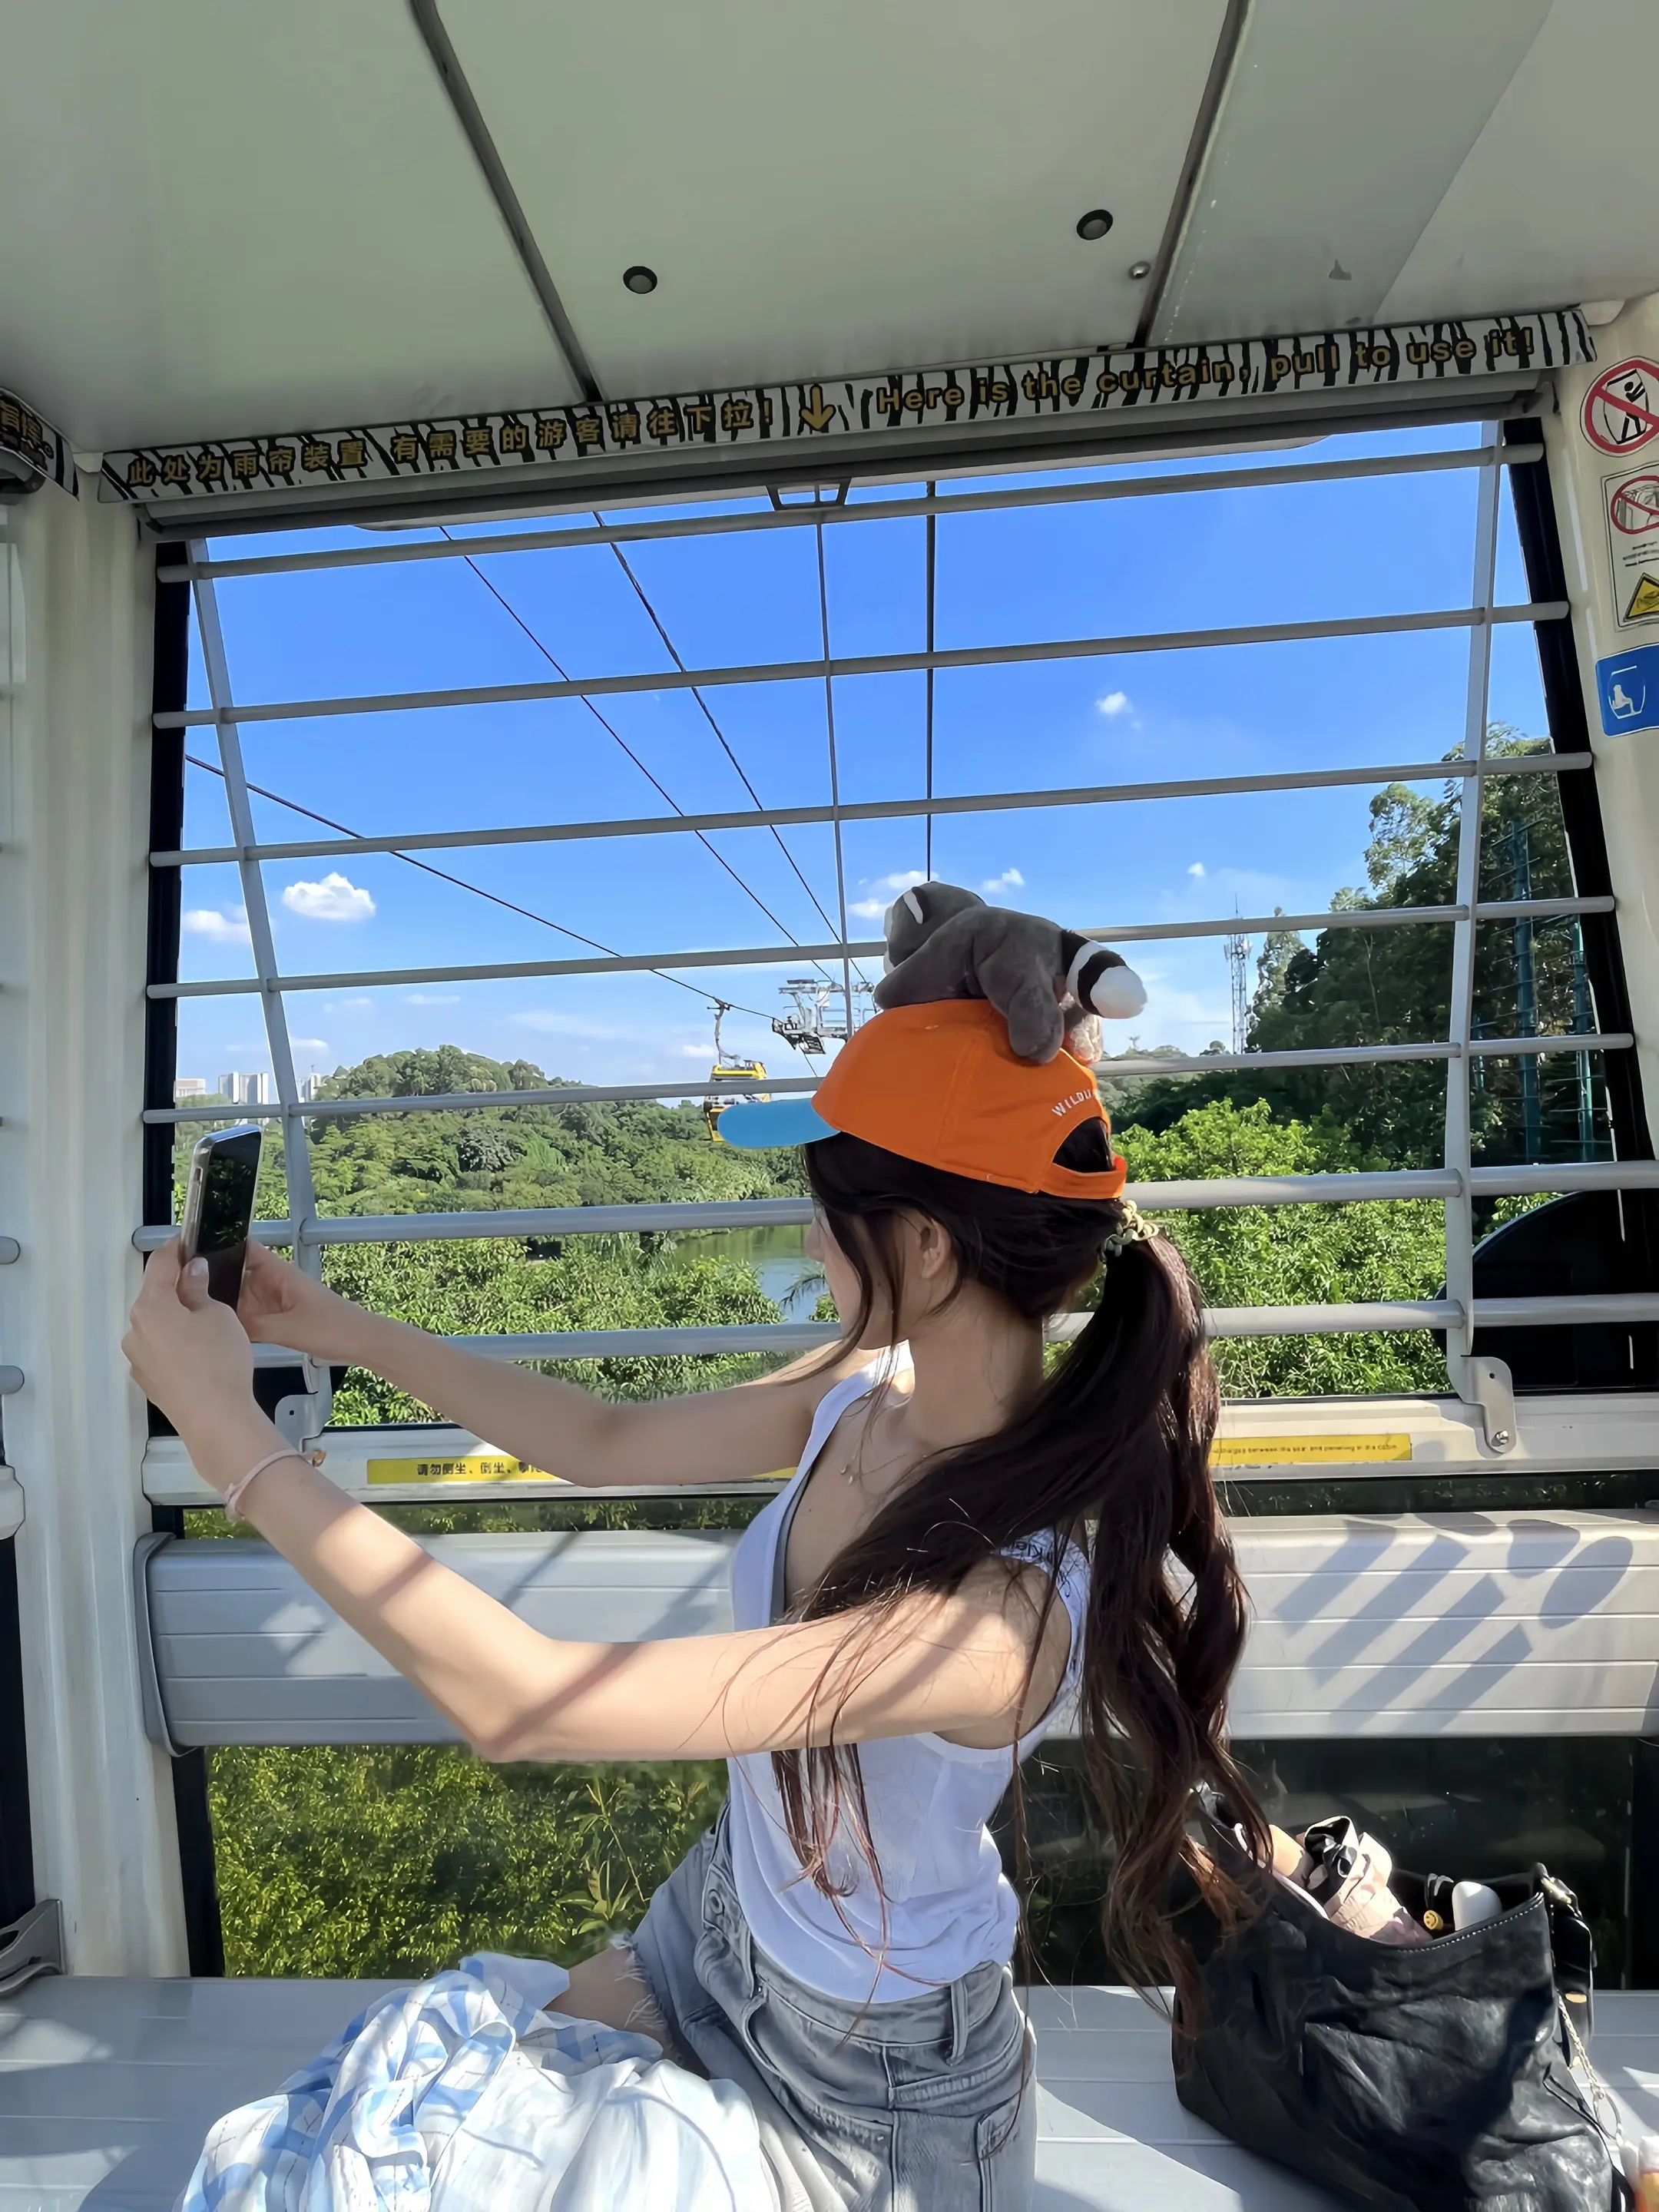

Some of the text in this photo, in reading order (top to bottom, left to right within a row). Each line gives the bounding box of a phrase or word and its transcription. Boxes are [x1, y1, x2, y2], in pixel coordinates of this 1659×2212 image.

[879, 328, 1534, 412] Here is the curtain, pull to use it!
[128, 399, 773, 486] 此处为雨帘装置 有需要的游客请往下拉！
